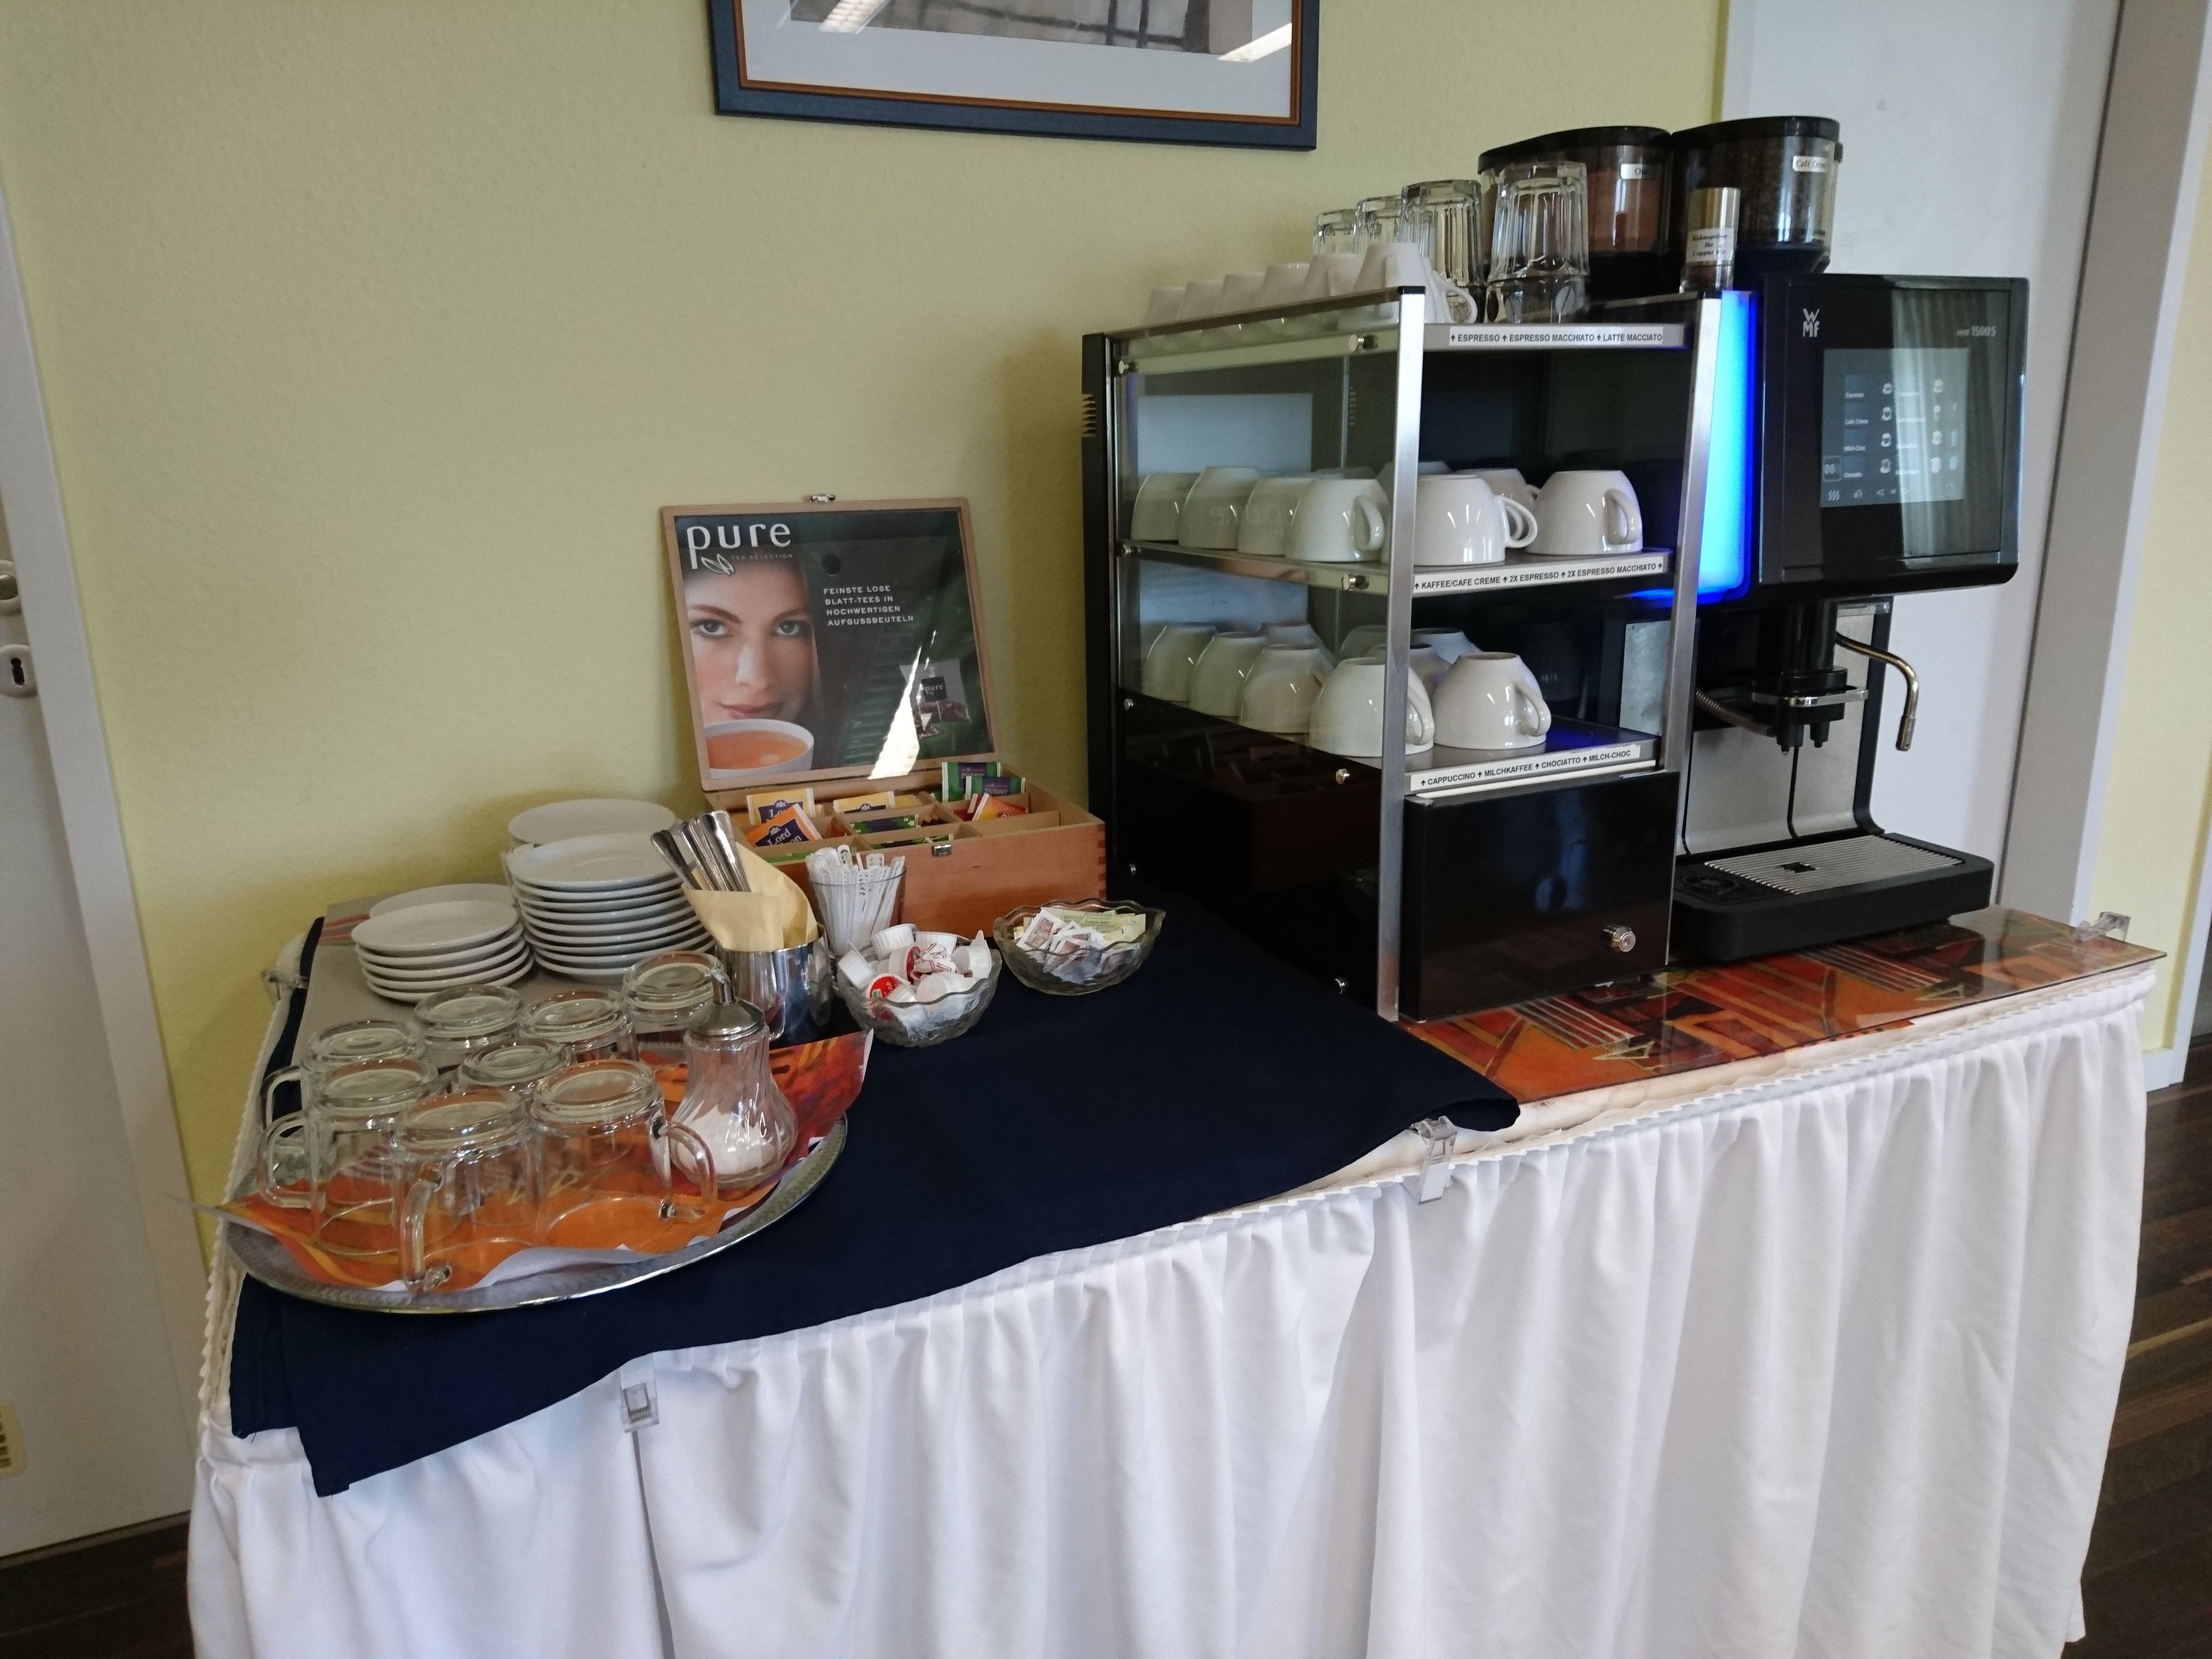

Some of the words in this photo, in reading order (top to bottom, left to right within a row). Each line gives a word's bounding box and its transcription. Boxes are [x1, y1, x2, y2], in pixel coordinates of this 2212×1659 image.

[1457, 334, 1501, 342] ESPRESSO
[1509, 334, 1550, 342] ESPRESSO
[1552, 333, 1594, 342] MACCHIATO
[1603, 334, 1625, 342] LATTE
[1627, 333, 1663, 342] MACCIATO
[687, 523, 791, 570] pure
[1421, 578, 1472, 589] KAFFEE/CAFE
[1474, 576, 1501, 585] CREME
[1509, 575, 1518, 583] 2X
[1520, 571, 1559, 581] ESPRESSO
[1577, 566, 1615, 577] ESPRESSO
[1616, 563, 1657, 574] MACCHIATO
[824, 586, 863, 594] FEINSTE
[825, 596, 880, 605] BLATT-TEES
[827, 605, 900, 616] HOCHWERTIGEN
[828, 615, 914, 626] AUFGUSSBEUTELN
[1427, 772, 1475, 785] CAPPUCCINO
[1484, 764, 1533, 777] MILCHKAFFEE
[1541, 757, 1581, 768] CHOCIATTO
[1589, 750, 1631, 762] MILCH-CHOC
